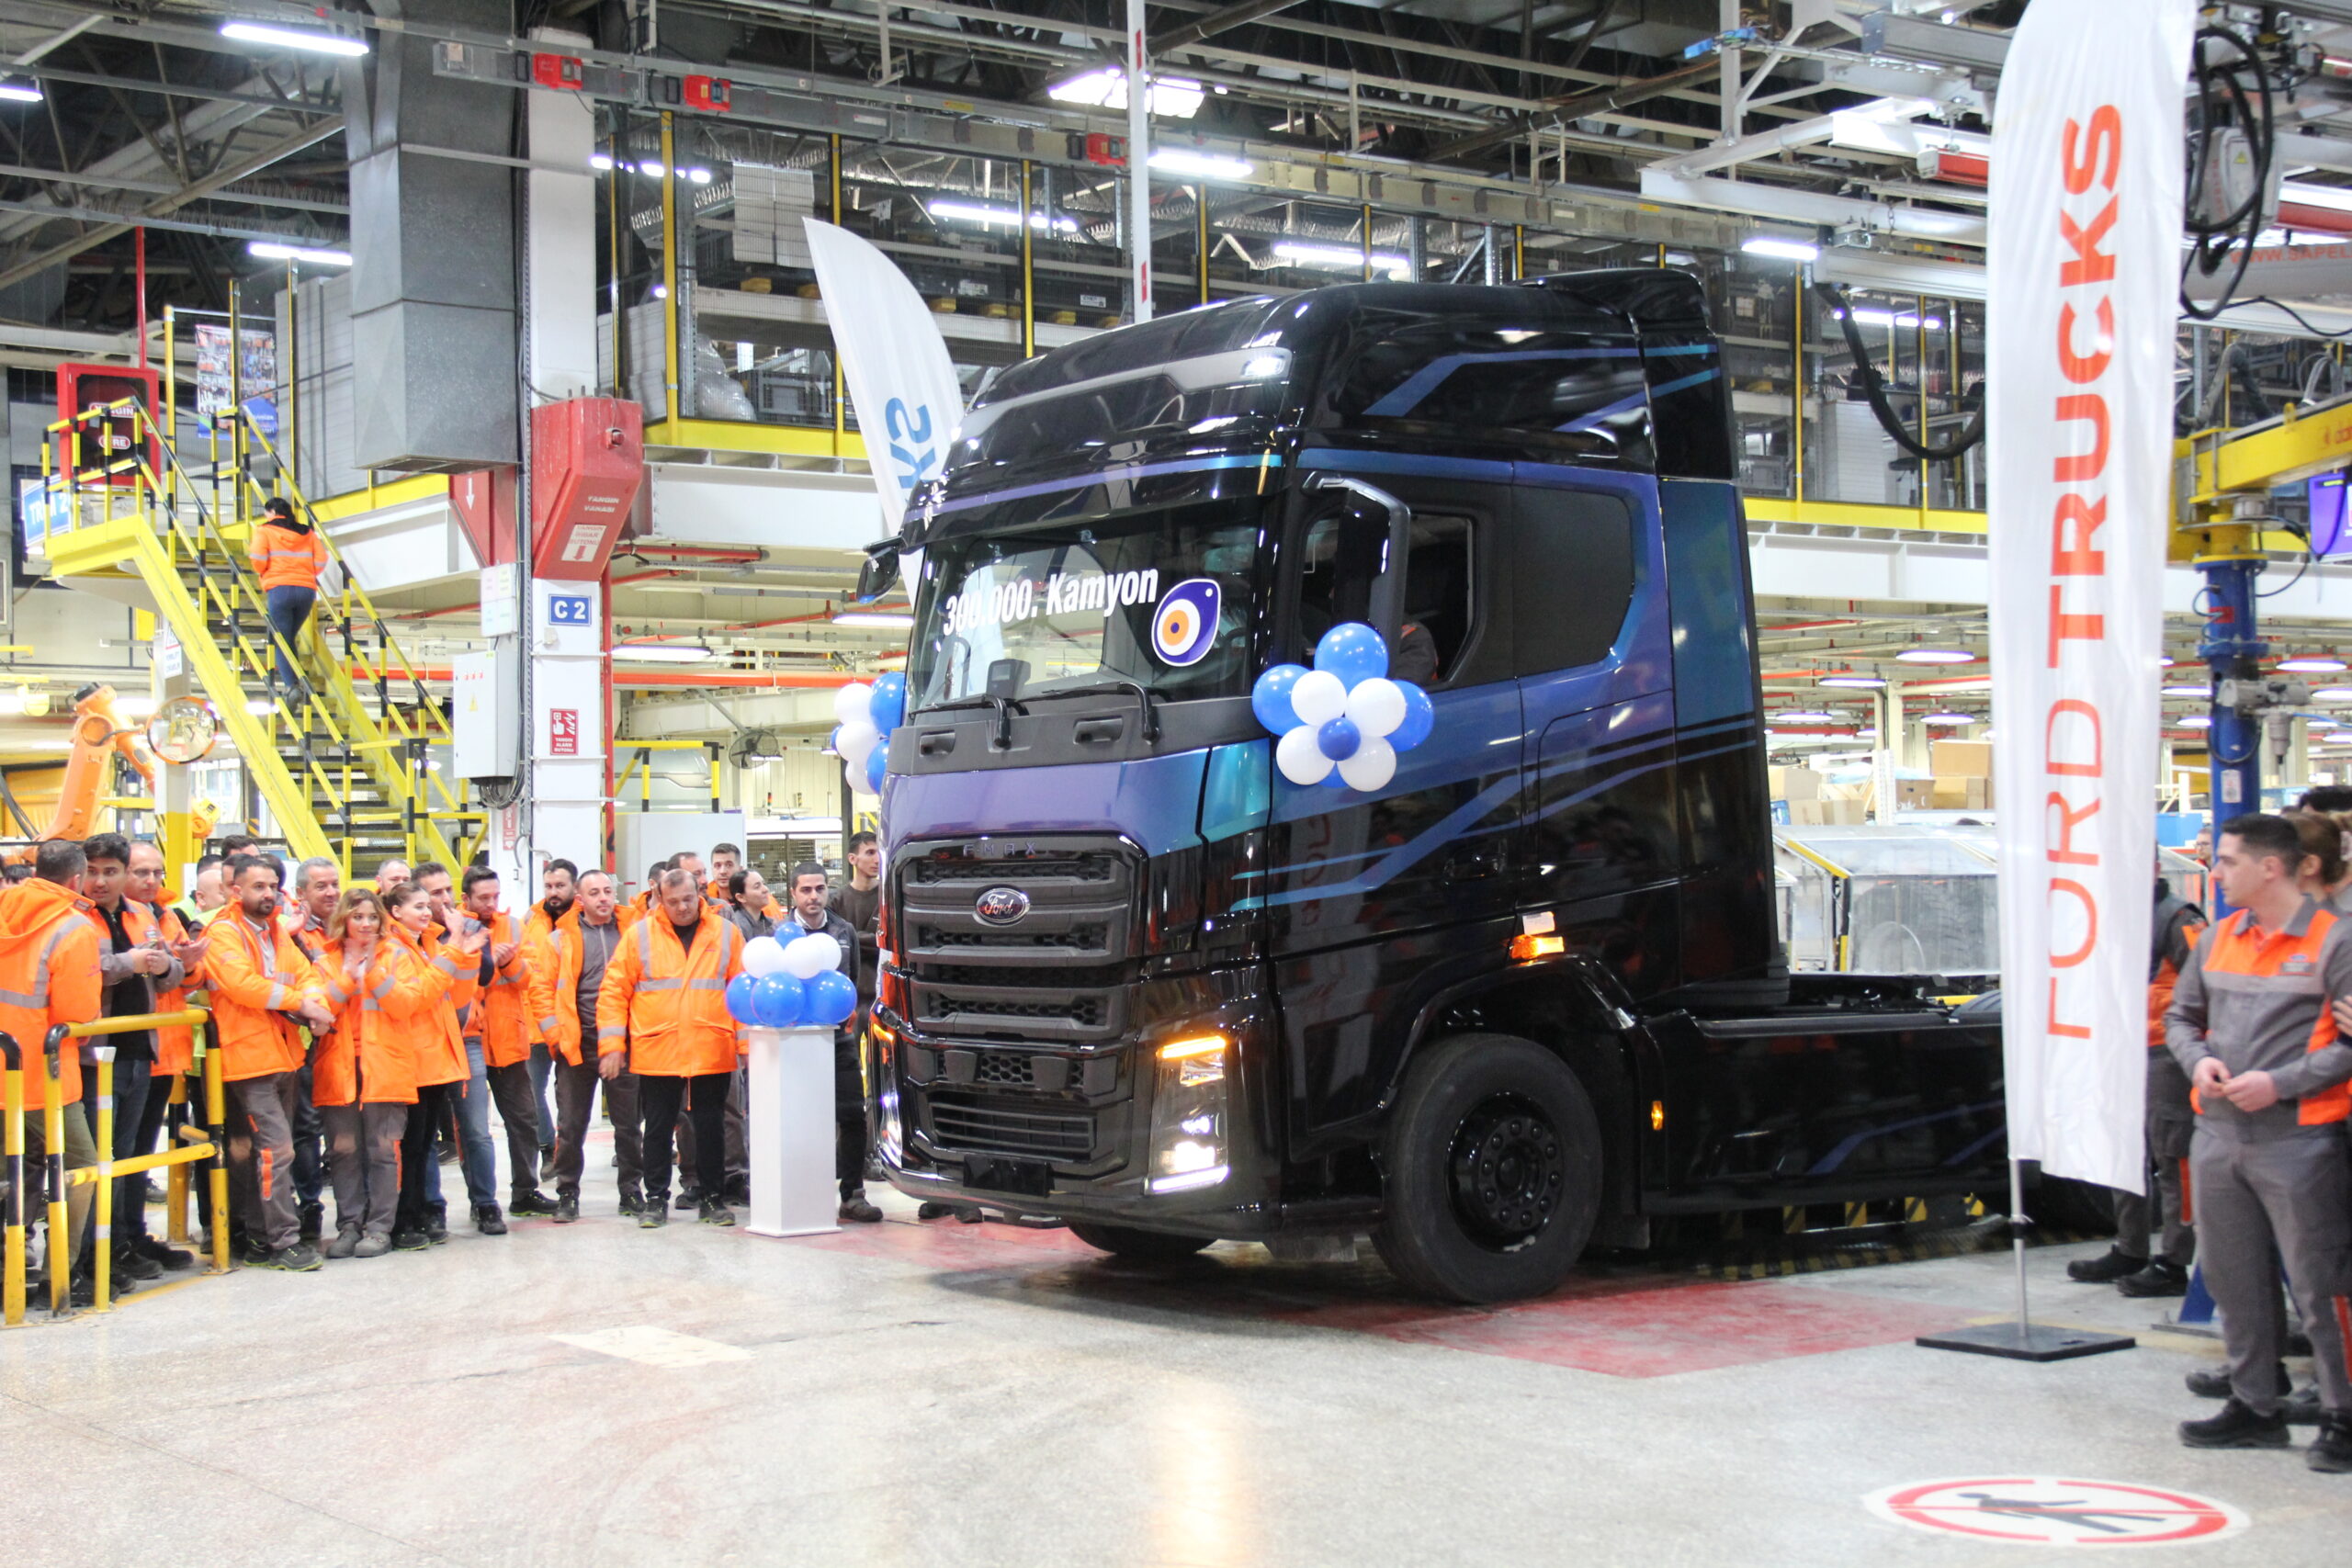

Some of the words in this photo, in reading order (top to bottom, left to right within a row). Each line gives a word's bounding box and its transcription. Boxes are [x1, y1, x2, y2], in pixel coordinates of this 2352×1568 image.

[2046, 104, 2121, 669] TRUCKS
[59, 491, 70, 513] 2
[554, 600, 568, 619] C
[573, 601, 586, 620] 2
[1046, 568, 1159, 617] Kamyon
[2044, 698, 2103, 1040] FORD
[983, 893, 1015, 916] Ford
